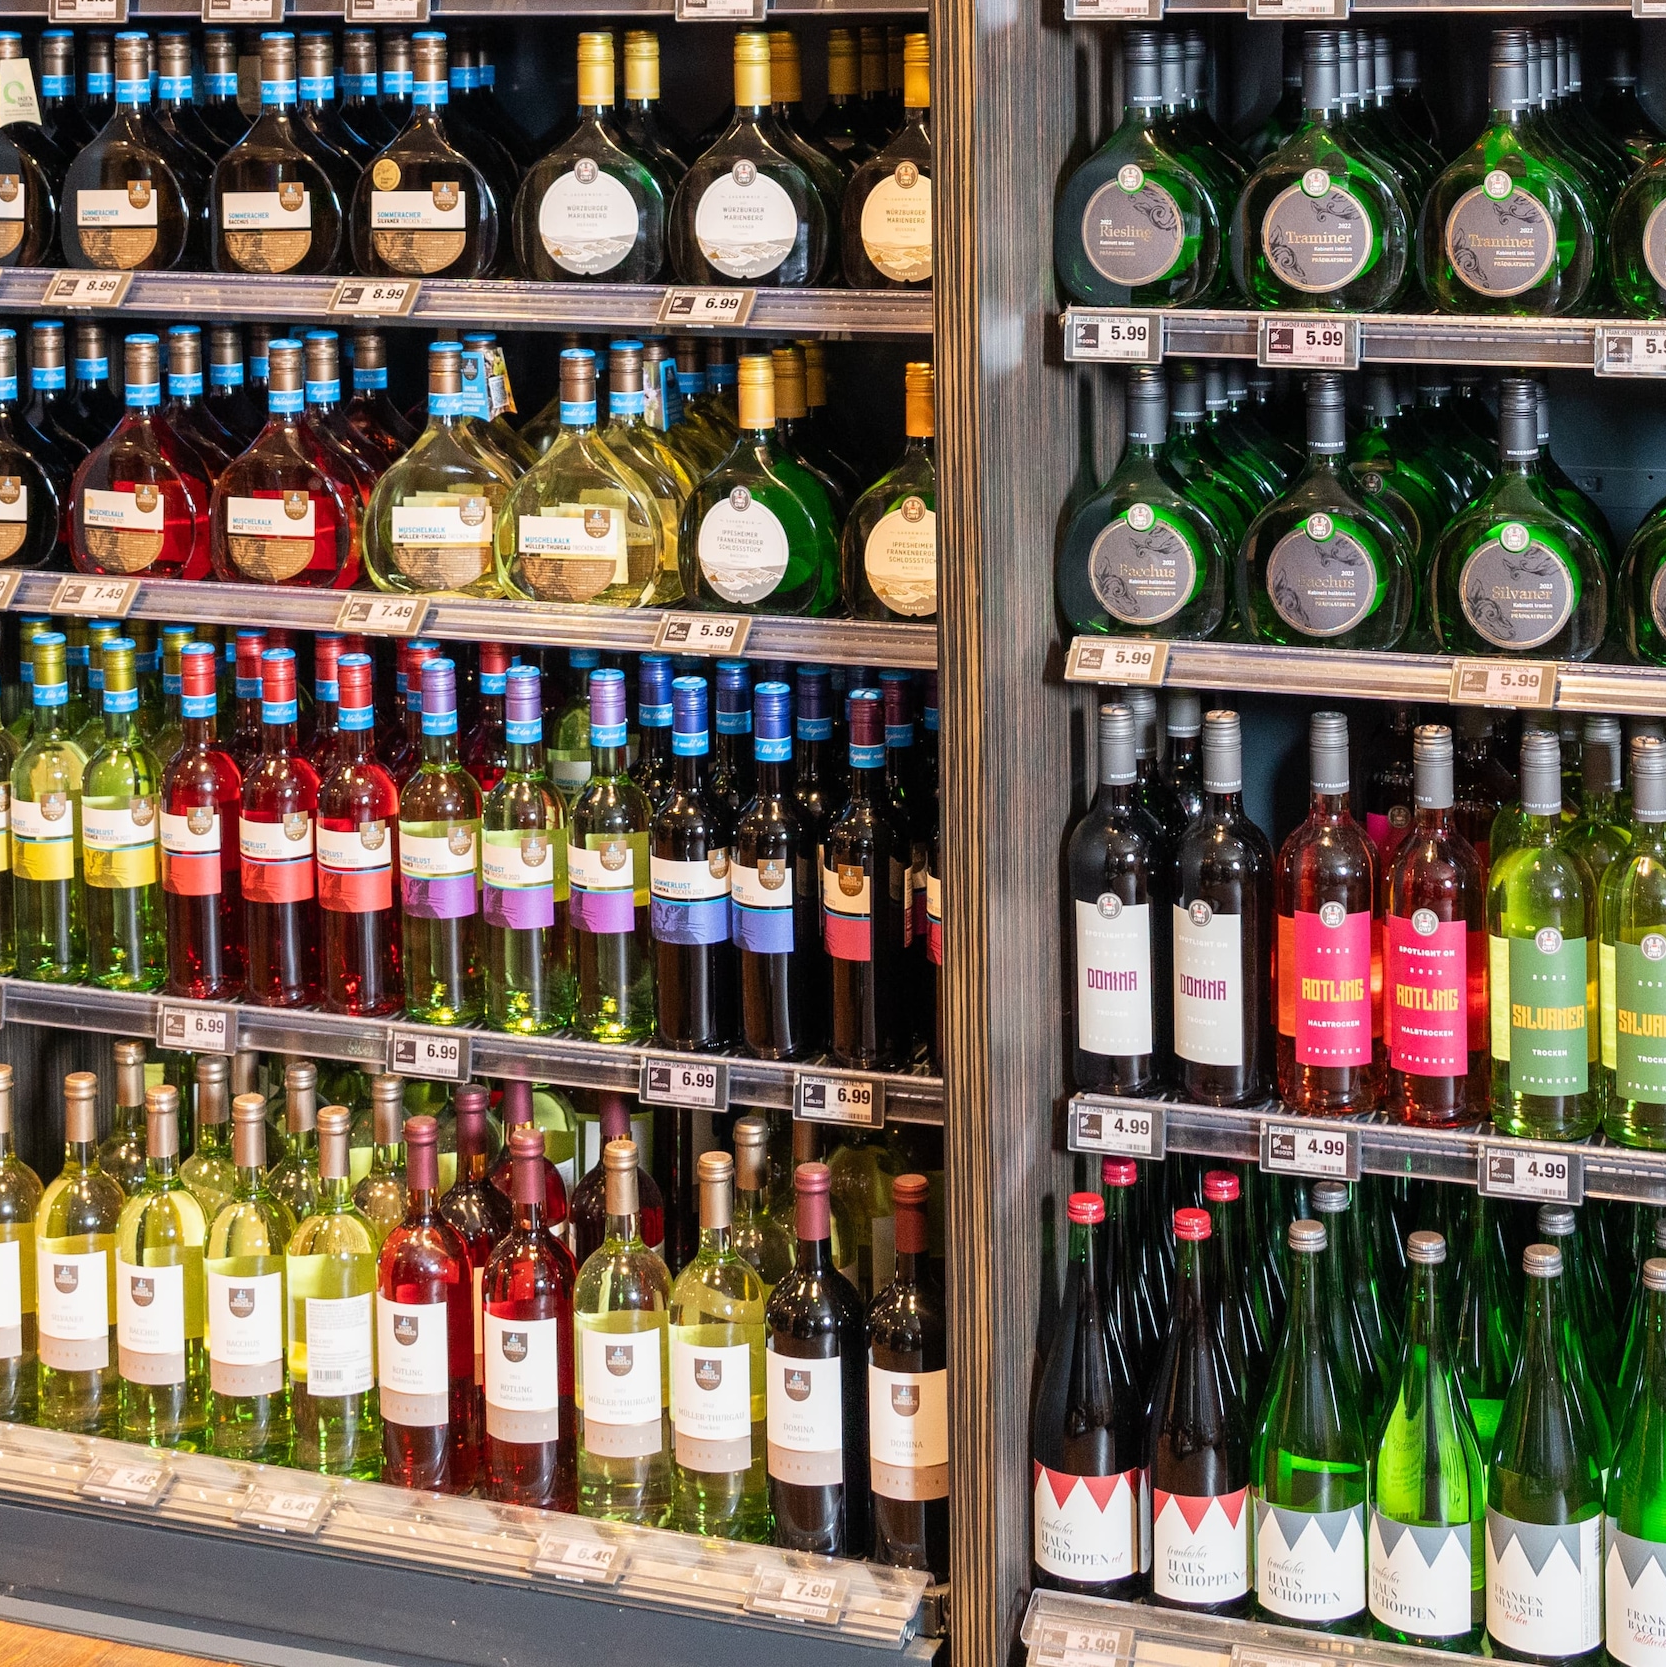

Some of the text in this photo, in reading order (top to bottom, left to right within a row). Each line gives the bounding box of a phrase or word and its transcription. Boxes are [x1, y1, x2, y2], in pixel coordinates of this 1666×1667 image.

[722, 205, 765, 214] WÜRZBURGER
[723, 213, 764, 222] MARIENBERG
[1100, 225, 1153, 240] Riesling
[1286, 231, 1352, 245] Traminer
[372, 288, 404, 300] 8.99
[705, 297, 739, 309] 6.99
[1110, 325, 1147, 342] 5.99
[524, 535, 571, 544] MUSCHELKALK
[721, 529, 758, 539] IPPESHEIMER
[716, 538, 764, 547] FRANKENBERGER
[1492, 585, 1553, 601] Silvaner
[700, 624, 734, 638] 5.99
[1115, 651, 1152, 668] 5.99
[1087, 968, 1138, 992] DOMINA
[1301, 978, 1365, 1002] ROTLING
[1308, 1018, 1361, 1029] HALBTROCKEN
[1513, 1004, 1585, 1031] SILVANER
[1532, 1048, 1568, 1057] TROCKEN
[1112, 1116, 1151, 1136] 4.99
[1042, 1529, 1071, 1549] HAUS
[1041, 1546, 1111, 1566] SCHOPPEN
[795, 1582, 832, 1600] 7.99
